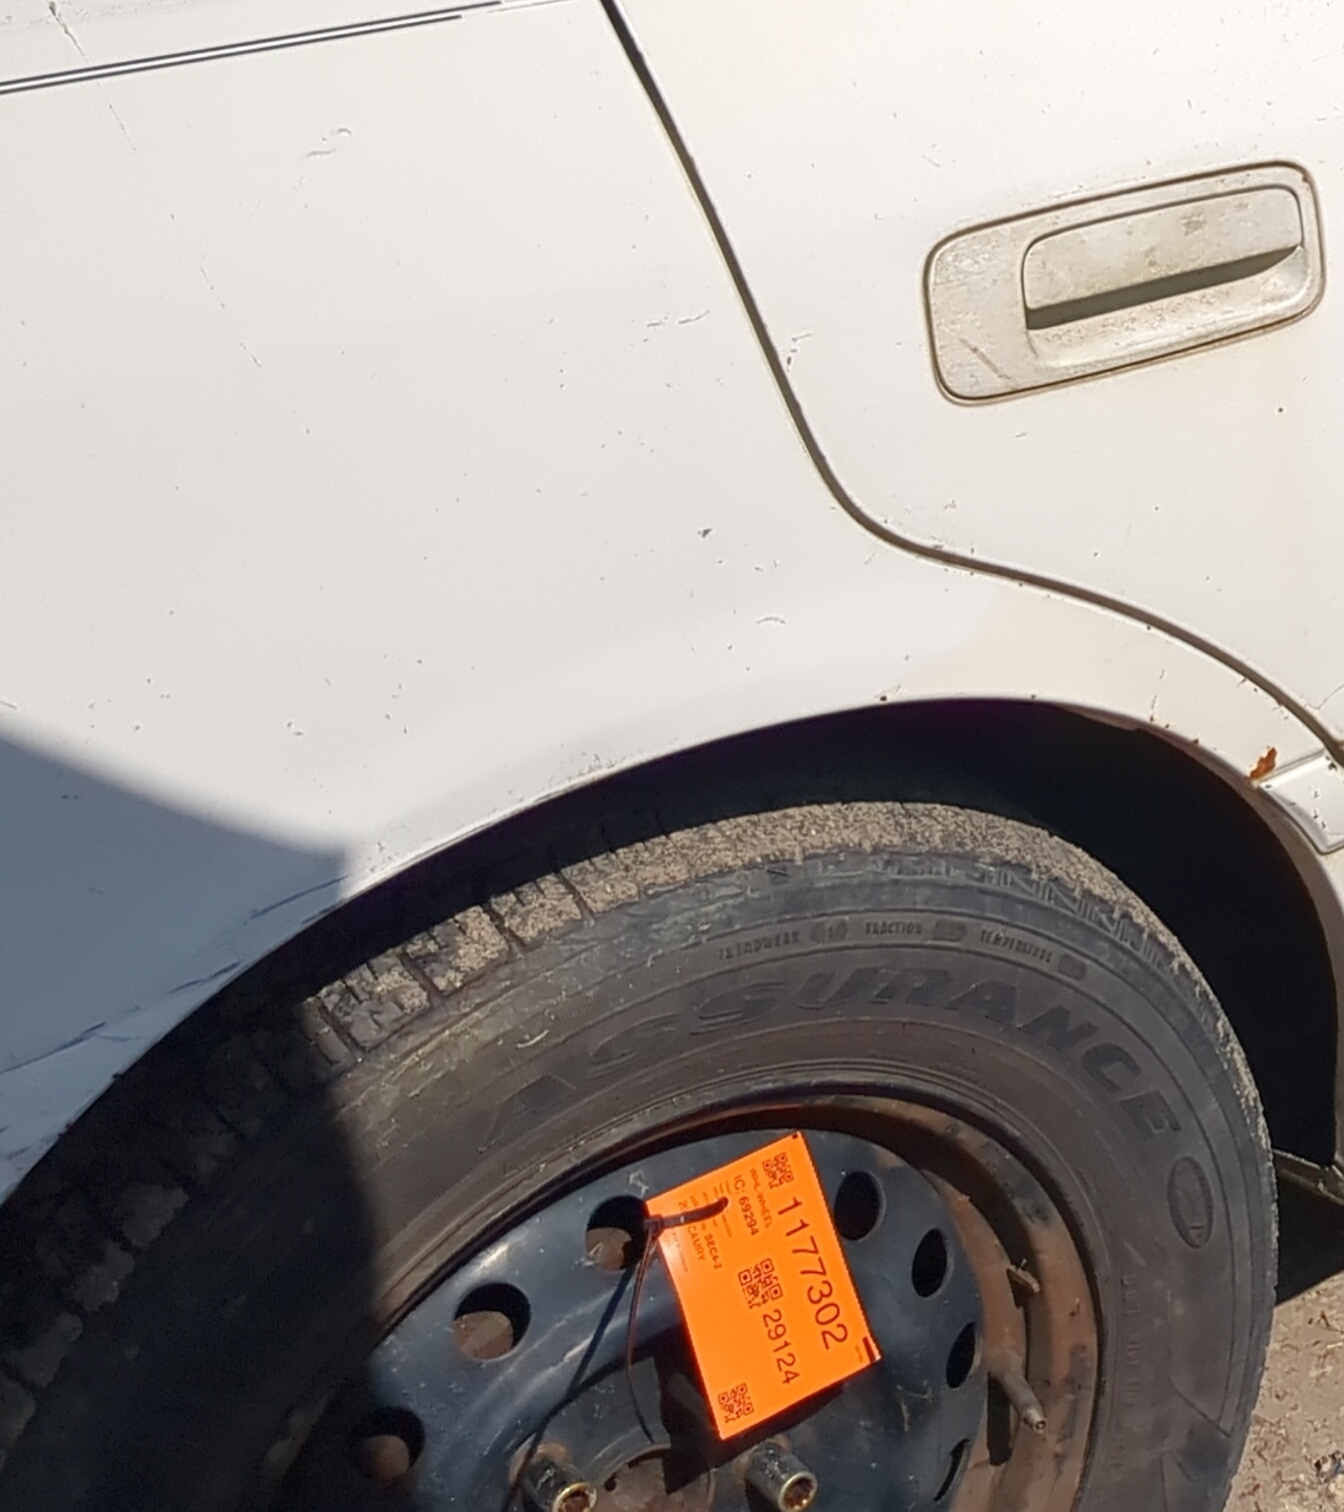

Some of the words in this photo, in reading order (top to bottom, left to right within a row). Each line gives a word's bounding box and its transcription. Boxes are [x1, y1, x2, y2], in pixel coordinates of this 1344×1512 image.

[739, 1196, 760, 1236] 69294
[778, 1196, 848, 1350] 1177302
[763, 1309, 800, 1384] 29124
